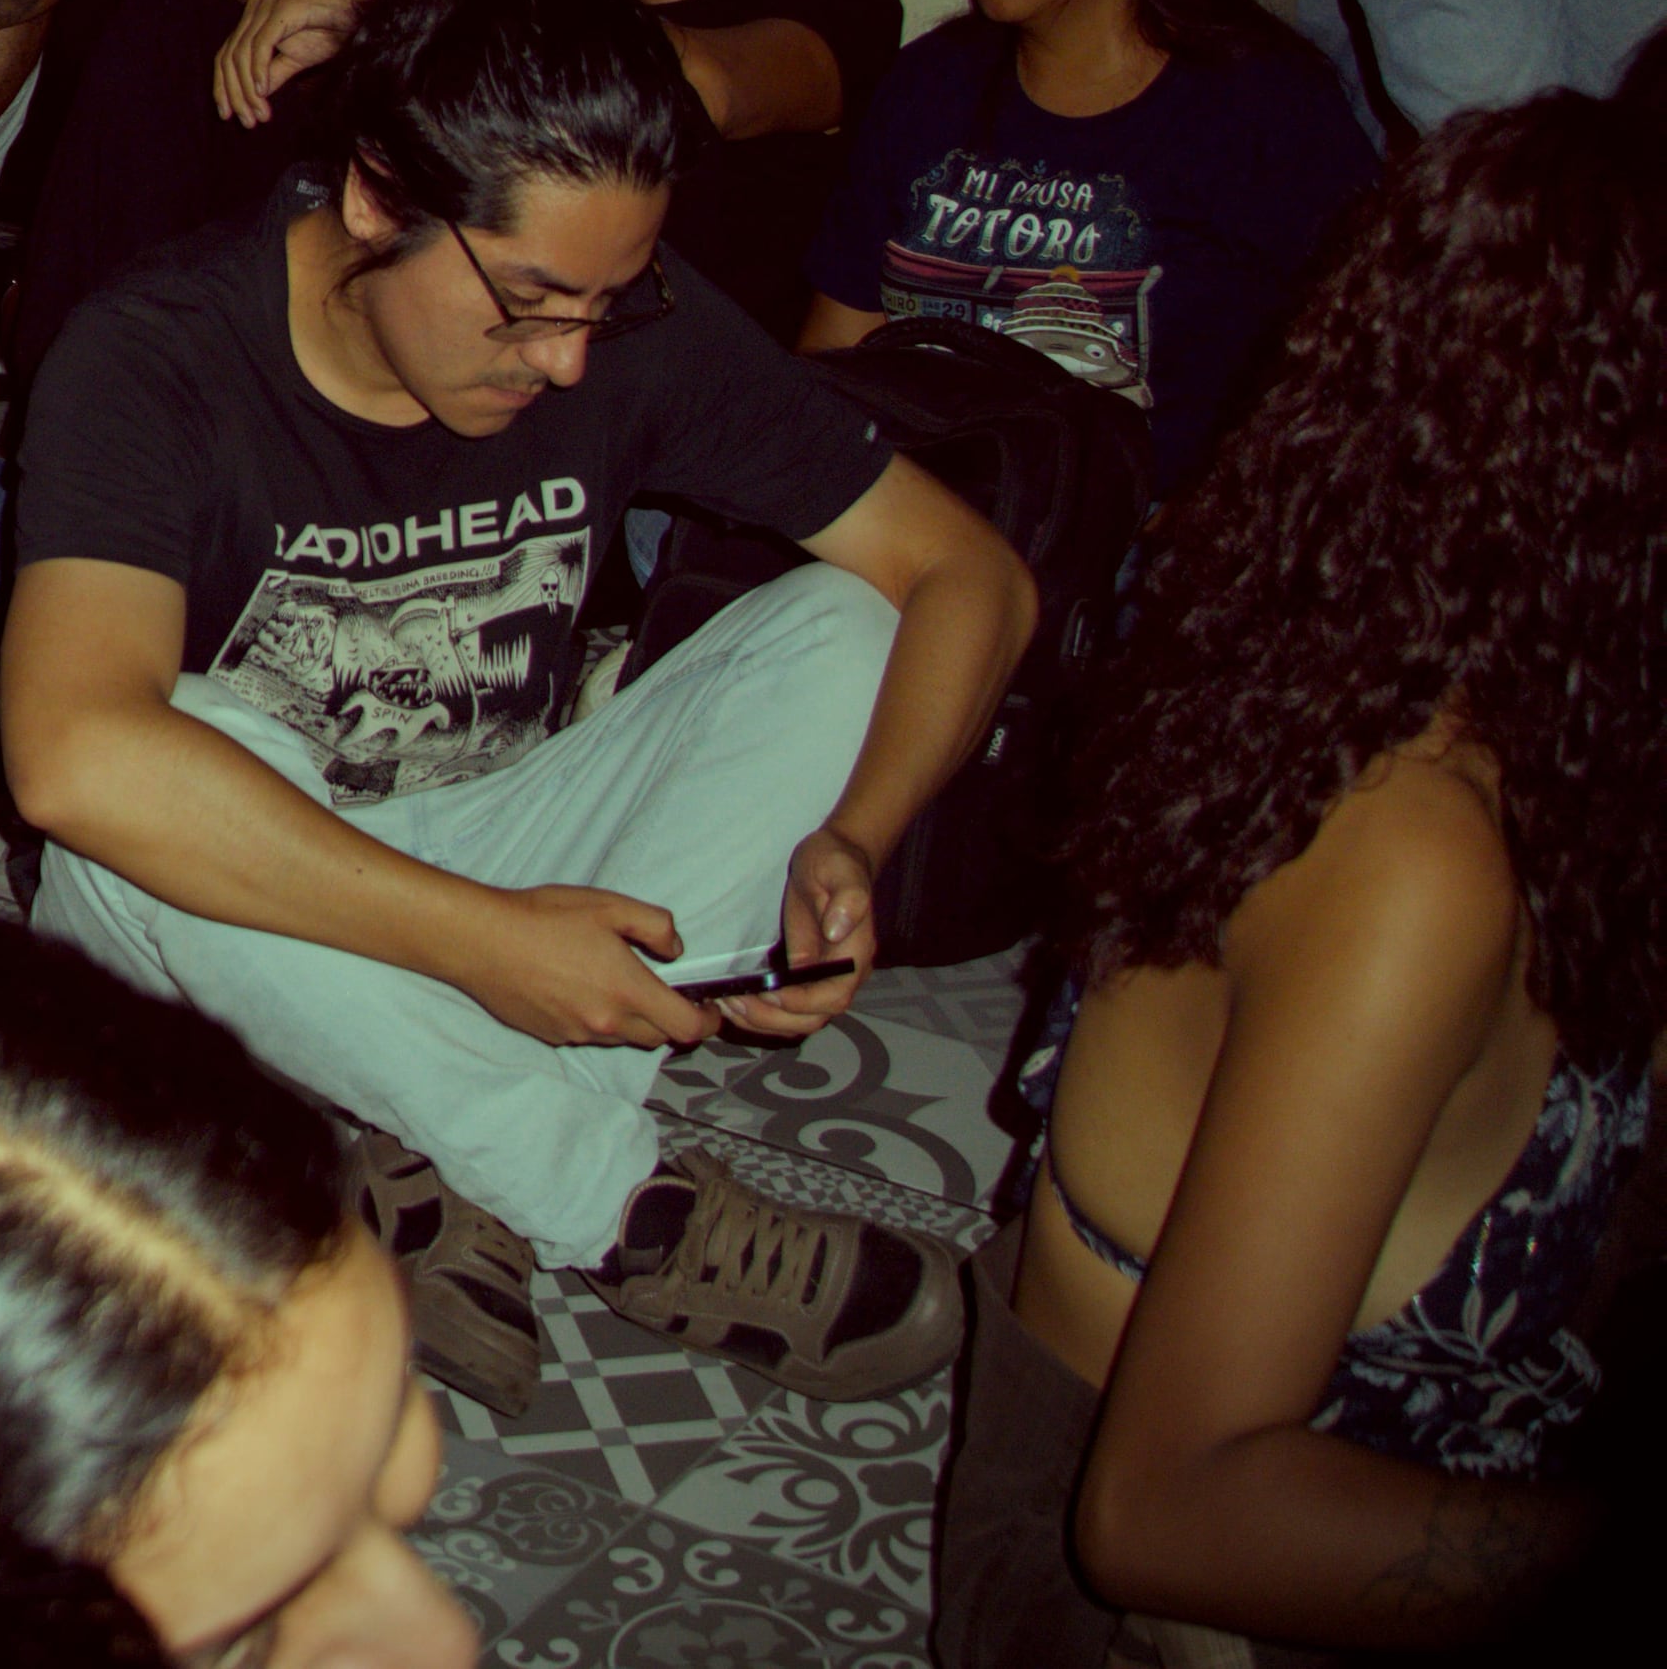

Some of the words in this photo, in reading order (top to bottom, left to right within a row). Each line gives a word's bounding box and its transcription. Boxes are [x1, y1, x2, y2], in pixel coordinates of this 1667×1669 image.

[961, 166, 1000, 202] MI
[920, 193, 1102, 264] TOTORO
[371, 706, 414, 725] SPIN
